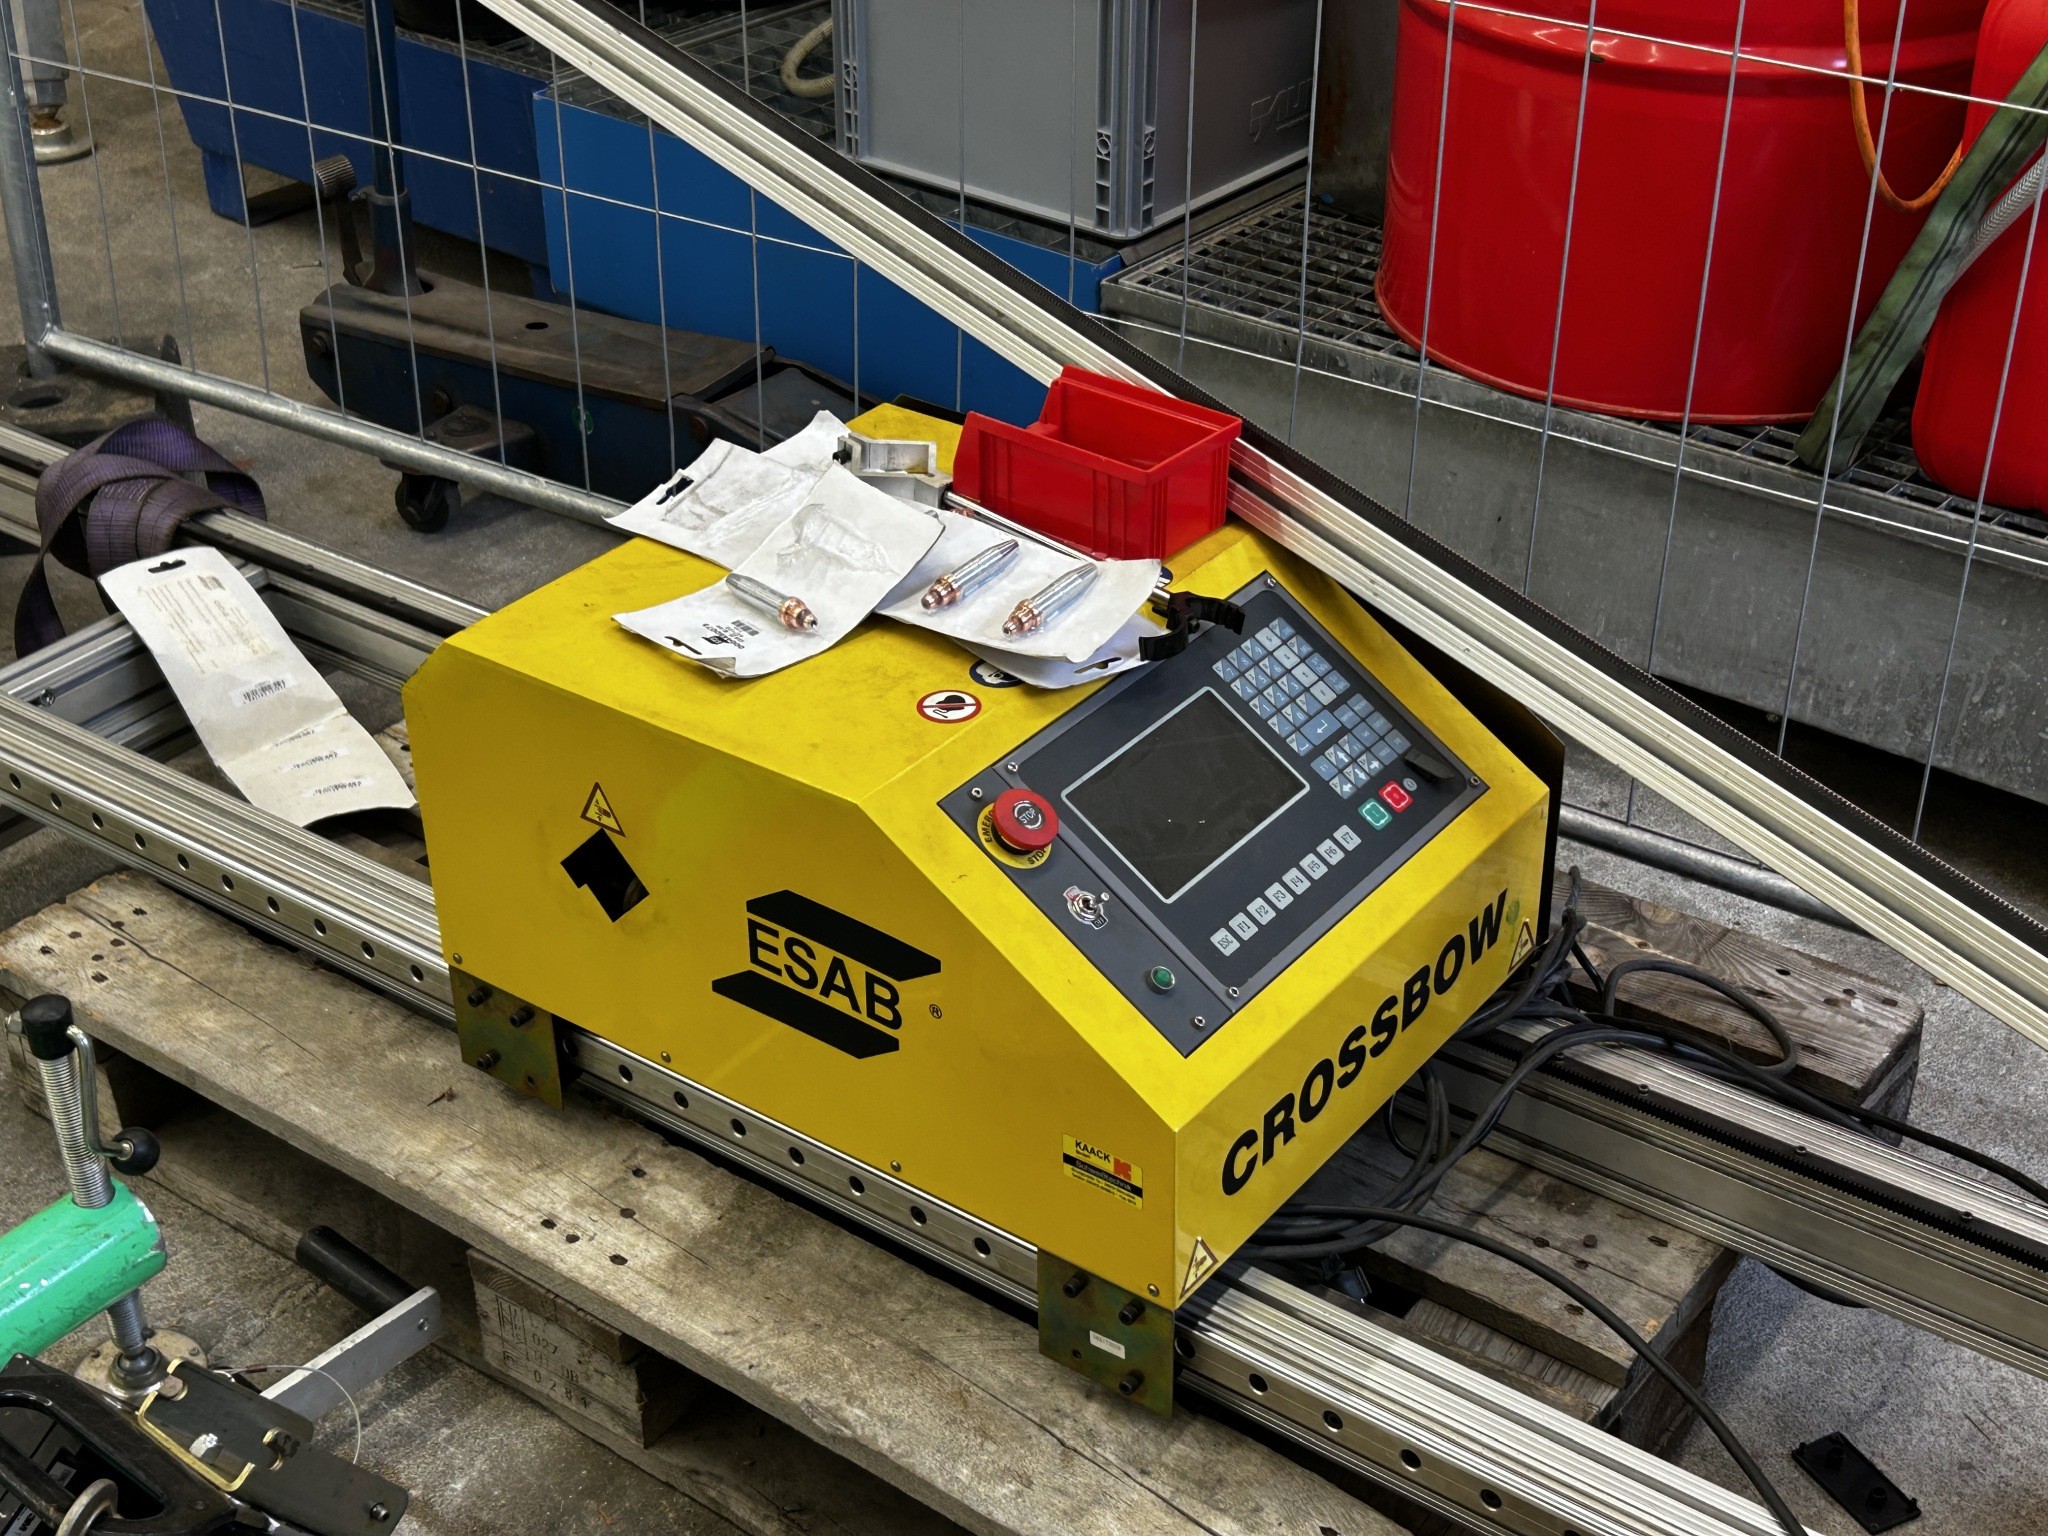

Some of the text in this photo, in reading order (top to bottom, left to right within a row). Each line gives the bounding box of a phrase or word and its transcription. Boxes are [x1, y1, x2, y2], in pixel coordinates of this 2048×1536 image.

[1277, 692, 1286, 701] 2
[1018, 807, 1036, 824] STOP
[1217, 832, 1354, 949] ESC F1 F2 F3 F4 F5 F6 F7
[747, 918, 902, 1030] ESAB
[1221, 889, 1508, 1196] CROSSBOW
[1075, 1139, 1111, 1163] KAACK
